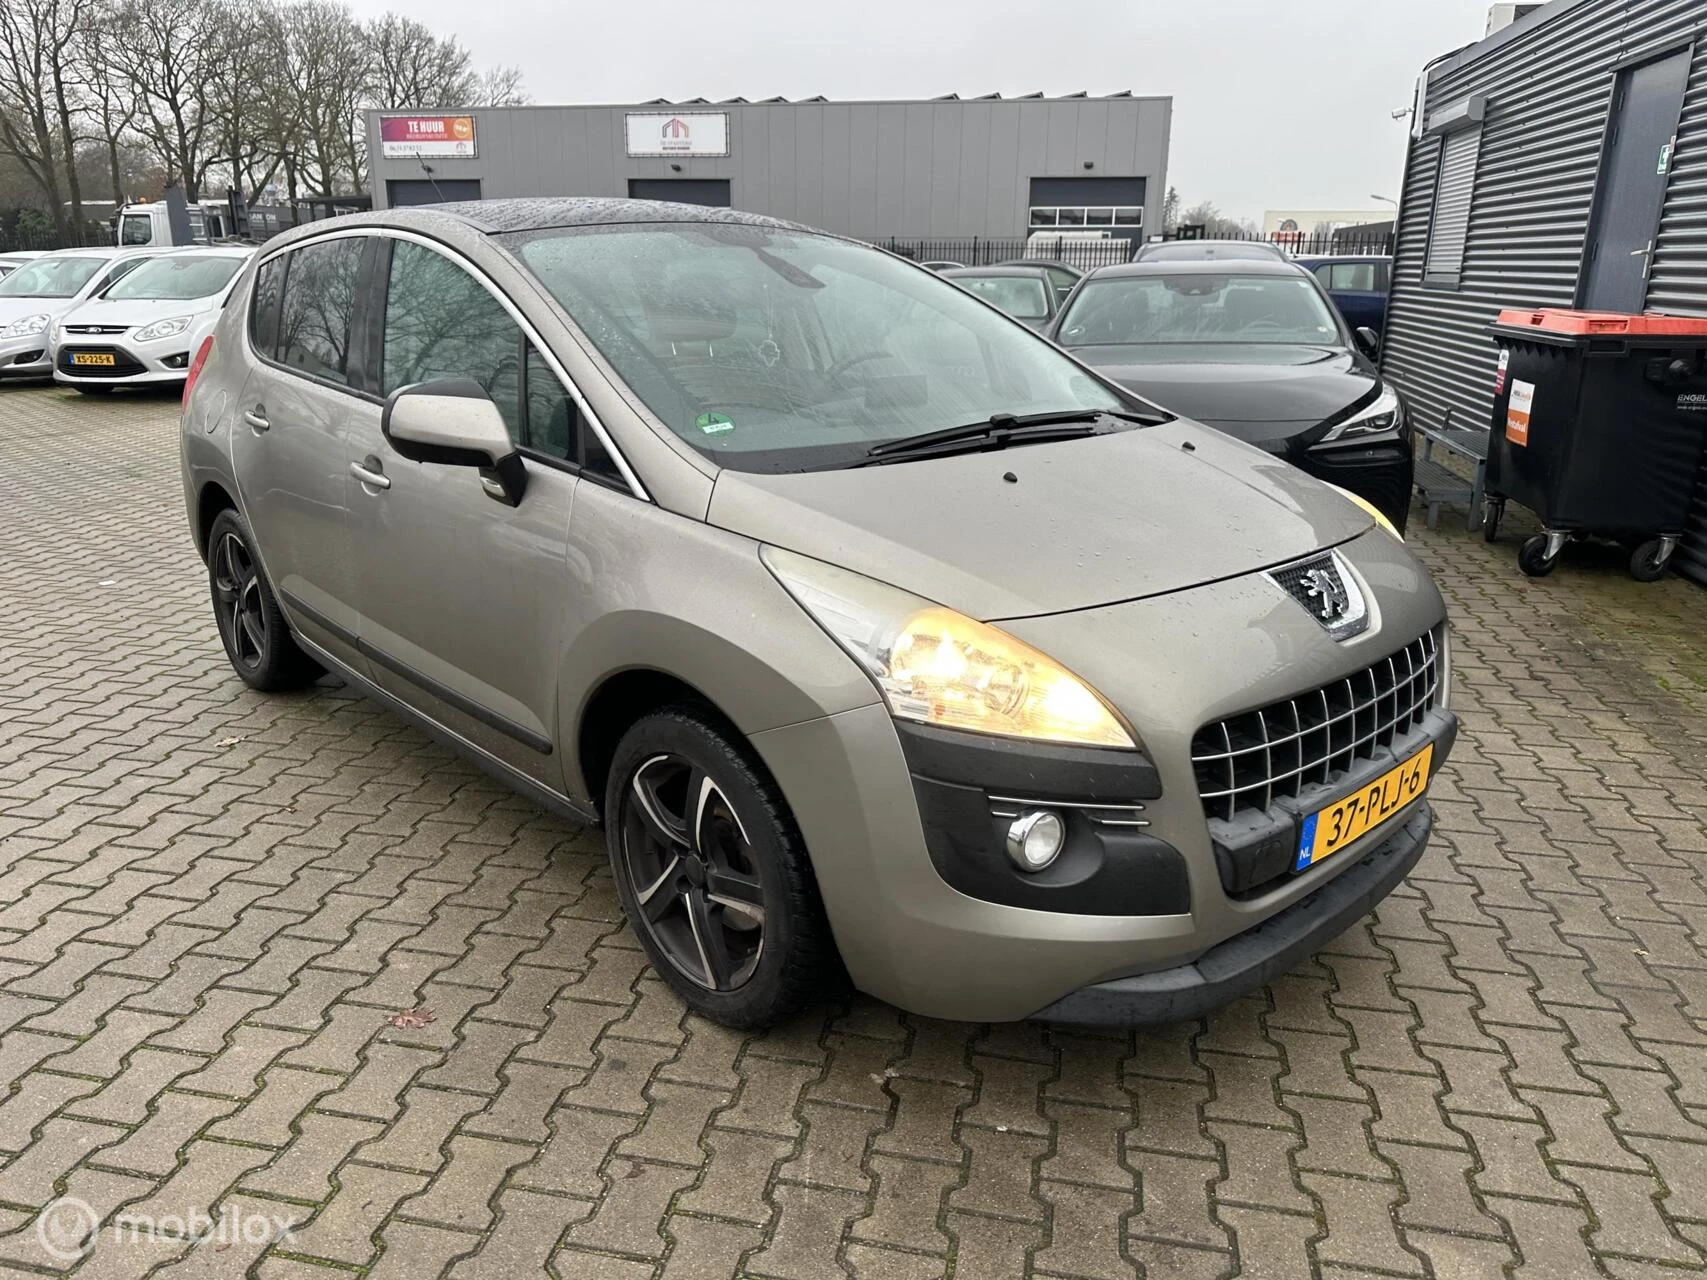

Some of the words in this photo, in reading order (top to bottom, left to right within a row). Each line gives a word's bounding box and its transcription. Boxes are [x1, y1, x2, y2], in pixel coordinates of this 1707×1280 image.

[408, 121, 419, 133] TE
[420, 121, 445, 133] HUUR
[76, 355, 112, 363] XS-225-K
[1326, 757, 1422, 847] 37-PLJ-6
[1299, 846, 1311, 860] NL
